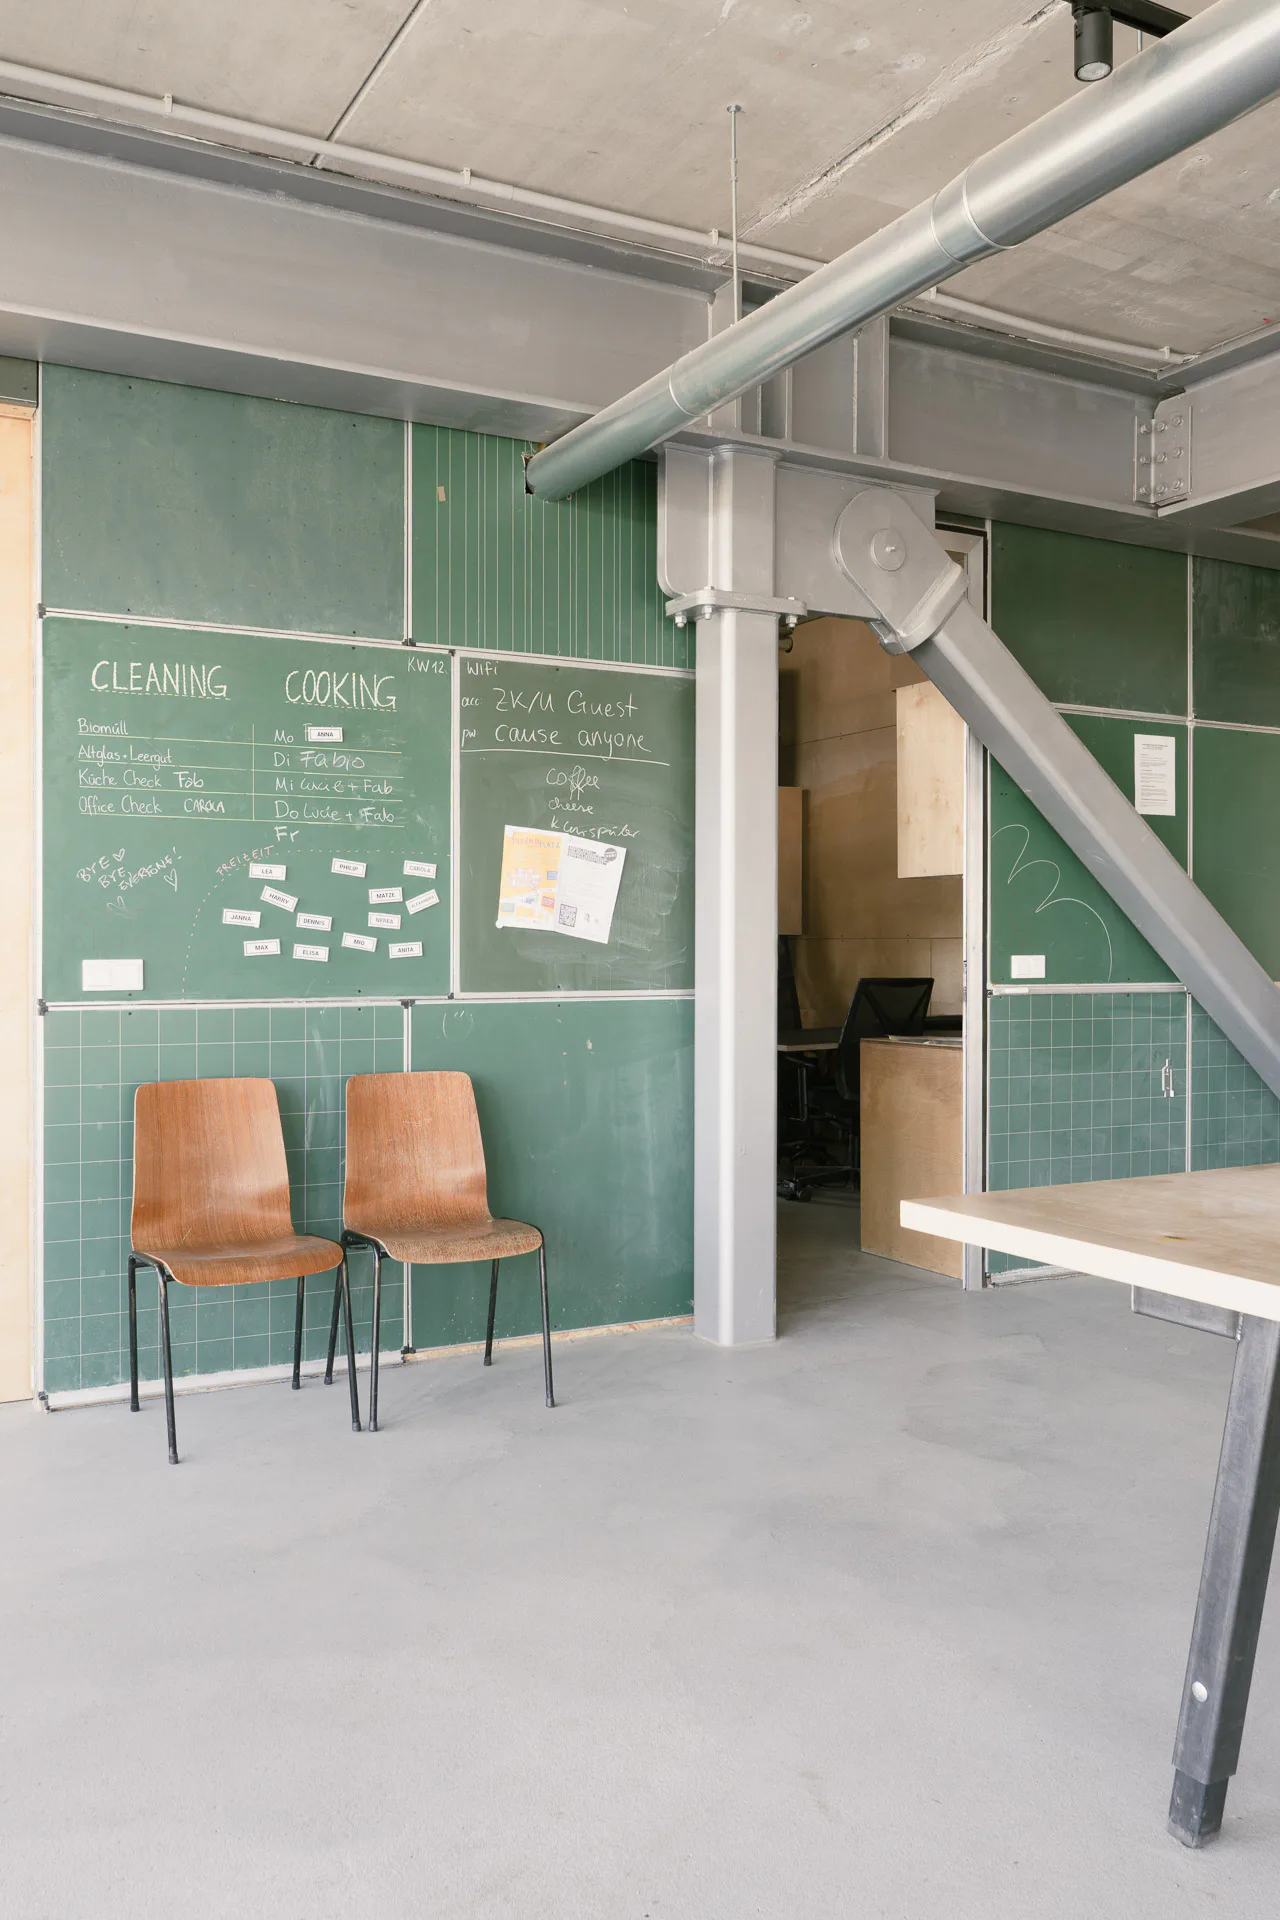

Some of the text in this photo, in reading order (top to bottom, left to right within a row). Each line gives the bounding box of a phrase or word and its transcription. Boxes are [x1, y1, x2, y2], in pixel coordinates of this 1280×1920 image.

[91, 660, 227, 697] CLEANING
[285, 669, 397, 709] COOKING
[567, 689, 638, 718] Guest
[77, 717, 128, 735] Biomüll
[274, 729, 294, 744] Mo
[578, 729, 652, 762] anyone
[78, 744, 120, 767] Altglas
[129, 744, 173, 771] Leergut
[273, 750, 366, 771] Di Fabio
[78, 768, 204, 788] Küche Check Fab
[275, 776, 294, 792] Mi
[348, 782, 358, 792] +
[363, 779, 393, 795] Fab
[78, 795, 225, 816] Office Check CAROLA
[274, 800, 395, 823] Do Lucie + Fab
[274, 825, 299, 841] Fr
[76, 855, 110, 883] BYE
[215, 844, 275, 876] FREIZEIT
[339, 863, 359, 871] PHILIP
[98, 866, 126, 889] BYE
[269, 892, 290, 905] HARRY
[376, 891, 395, 899] MATZE
[230, 914, 252, 922] JANNA
[303, 918, 325, 926] DENNIS
